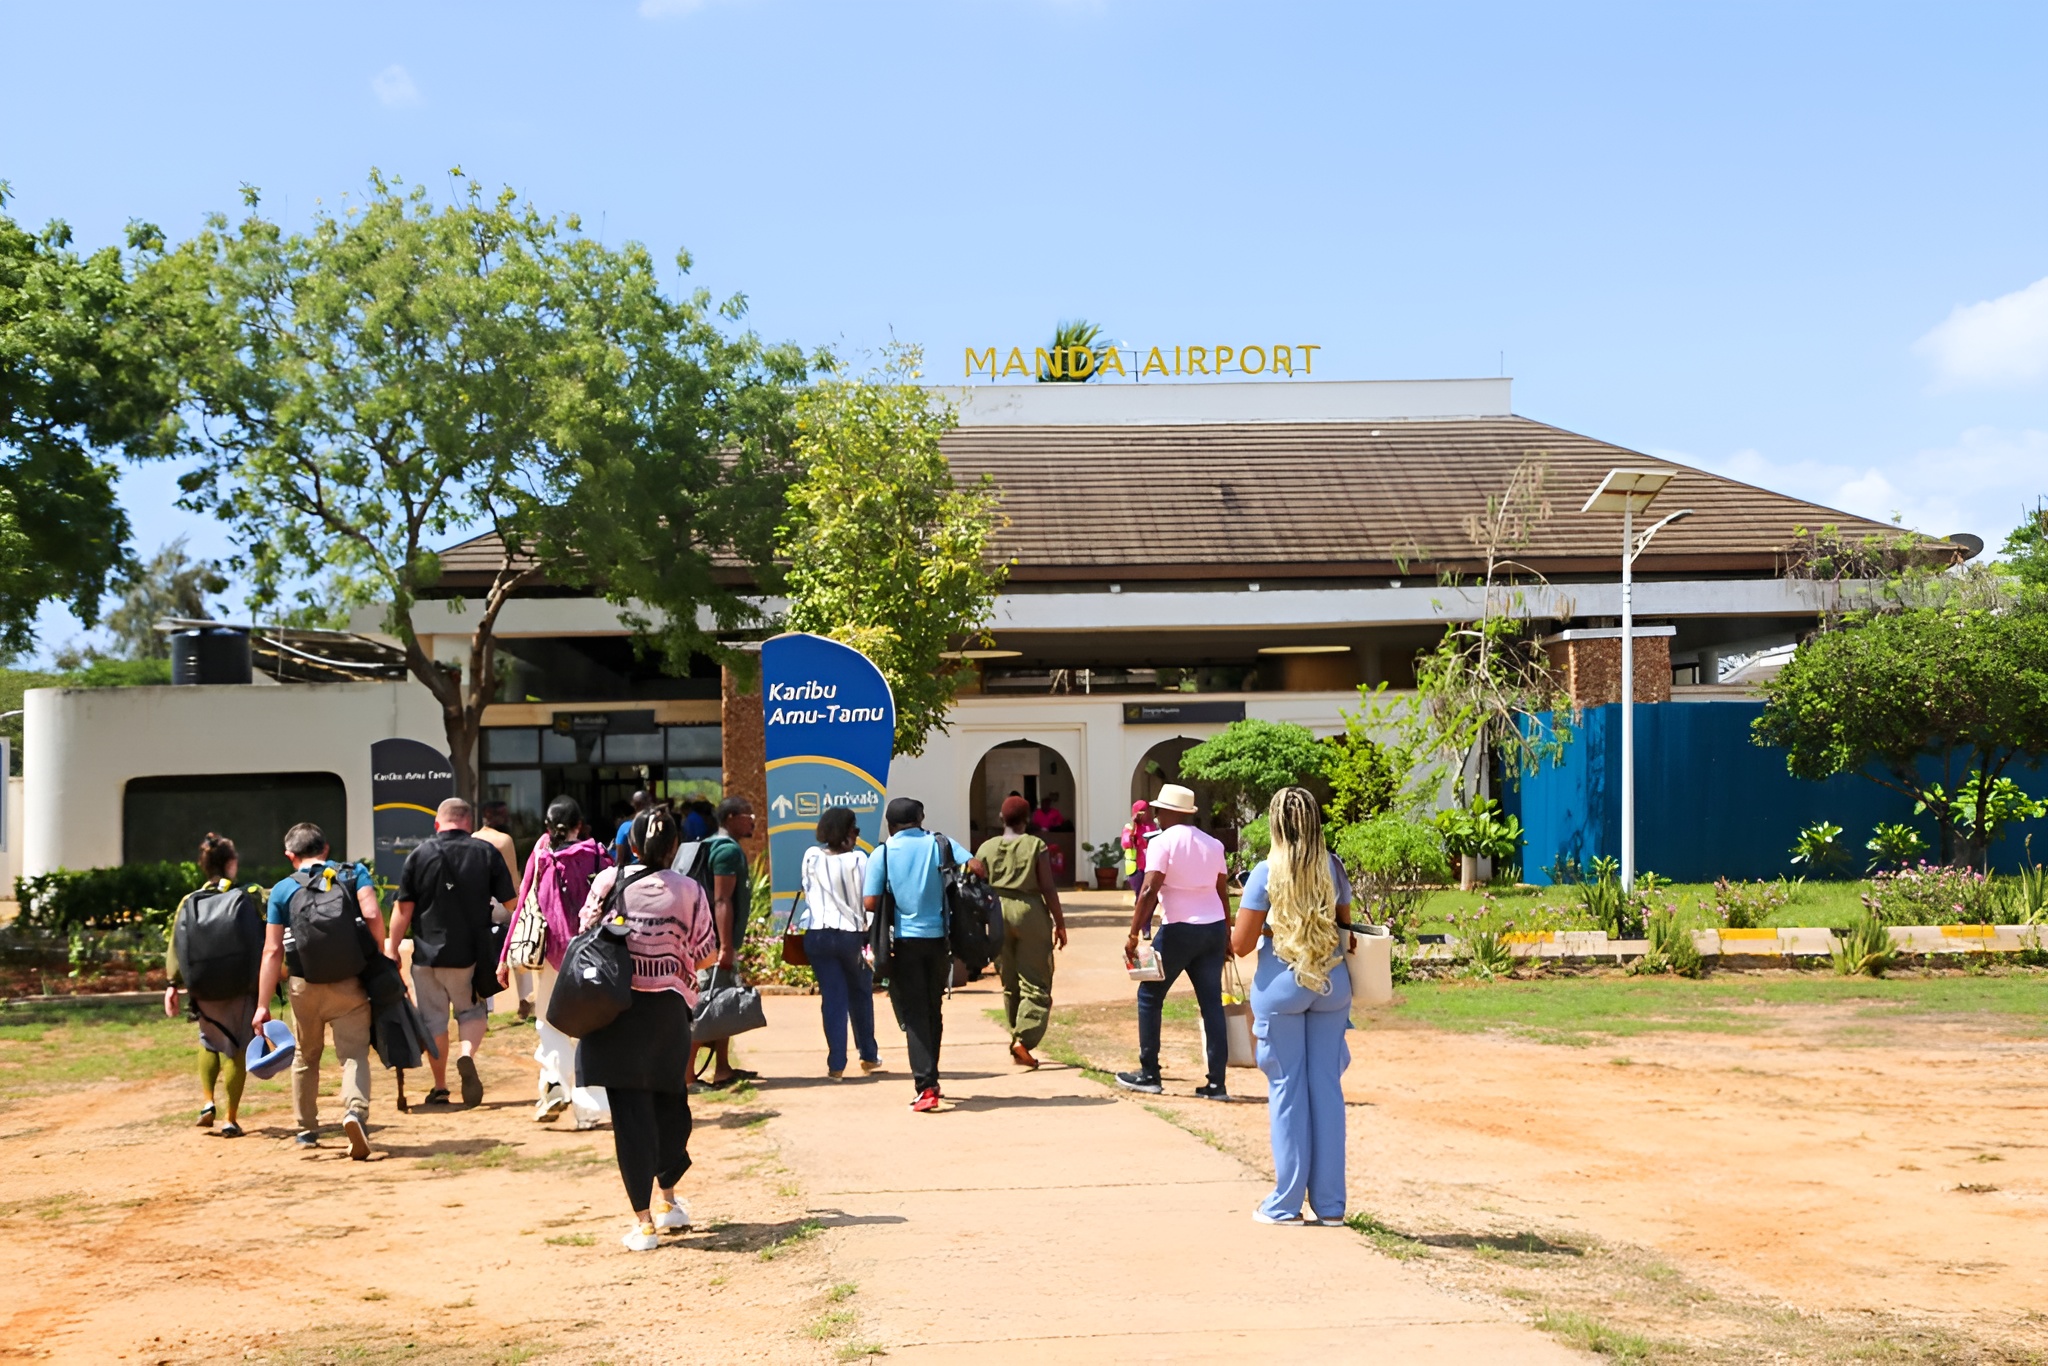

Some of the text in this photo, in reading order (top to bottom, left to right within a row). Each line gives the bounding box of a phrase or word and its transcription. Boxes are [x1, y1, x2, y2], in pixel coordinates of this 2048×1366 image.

[964, 345, 1321, 378] MANDA AIRPORT
[768, 680, 837, 702] Karibu
[768, 705, 884, 726] Amu-Tamu
